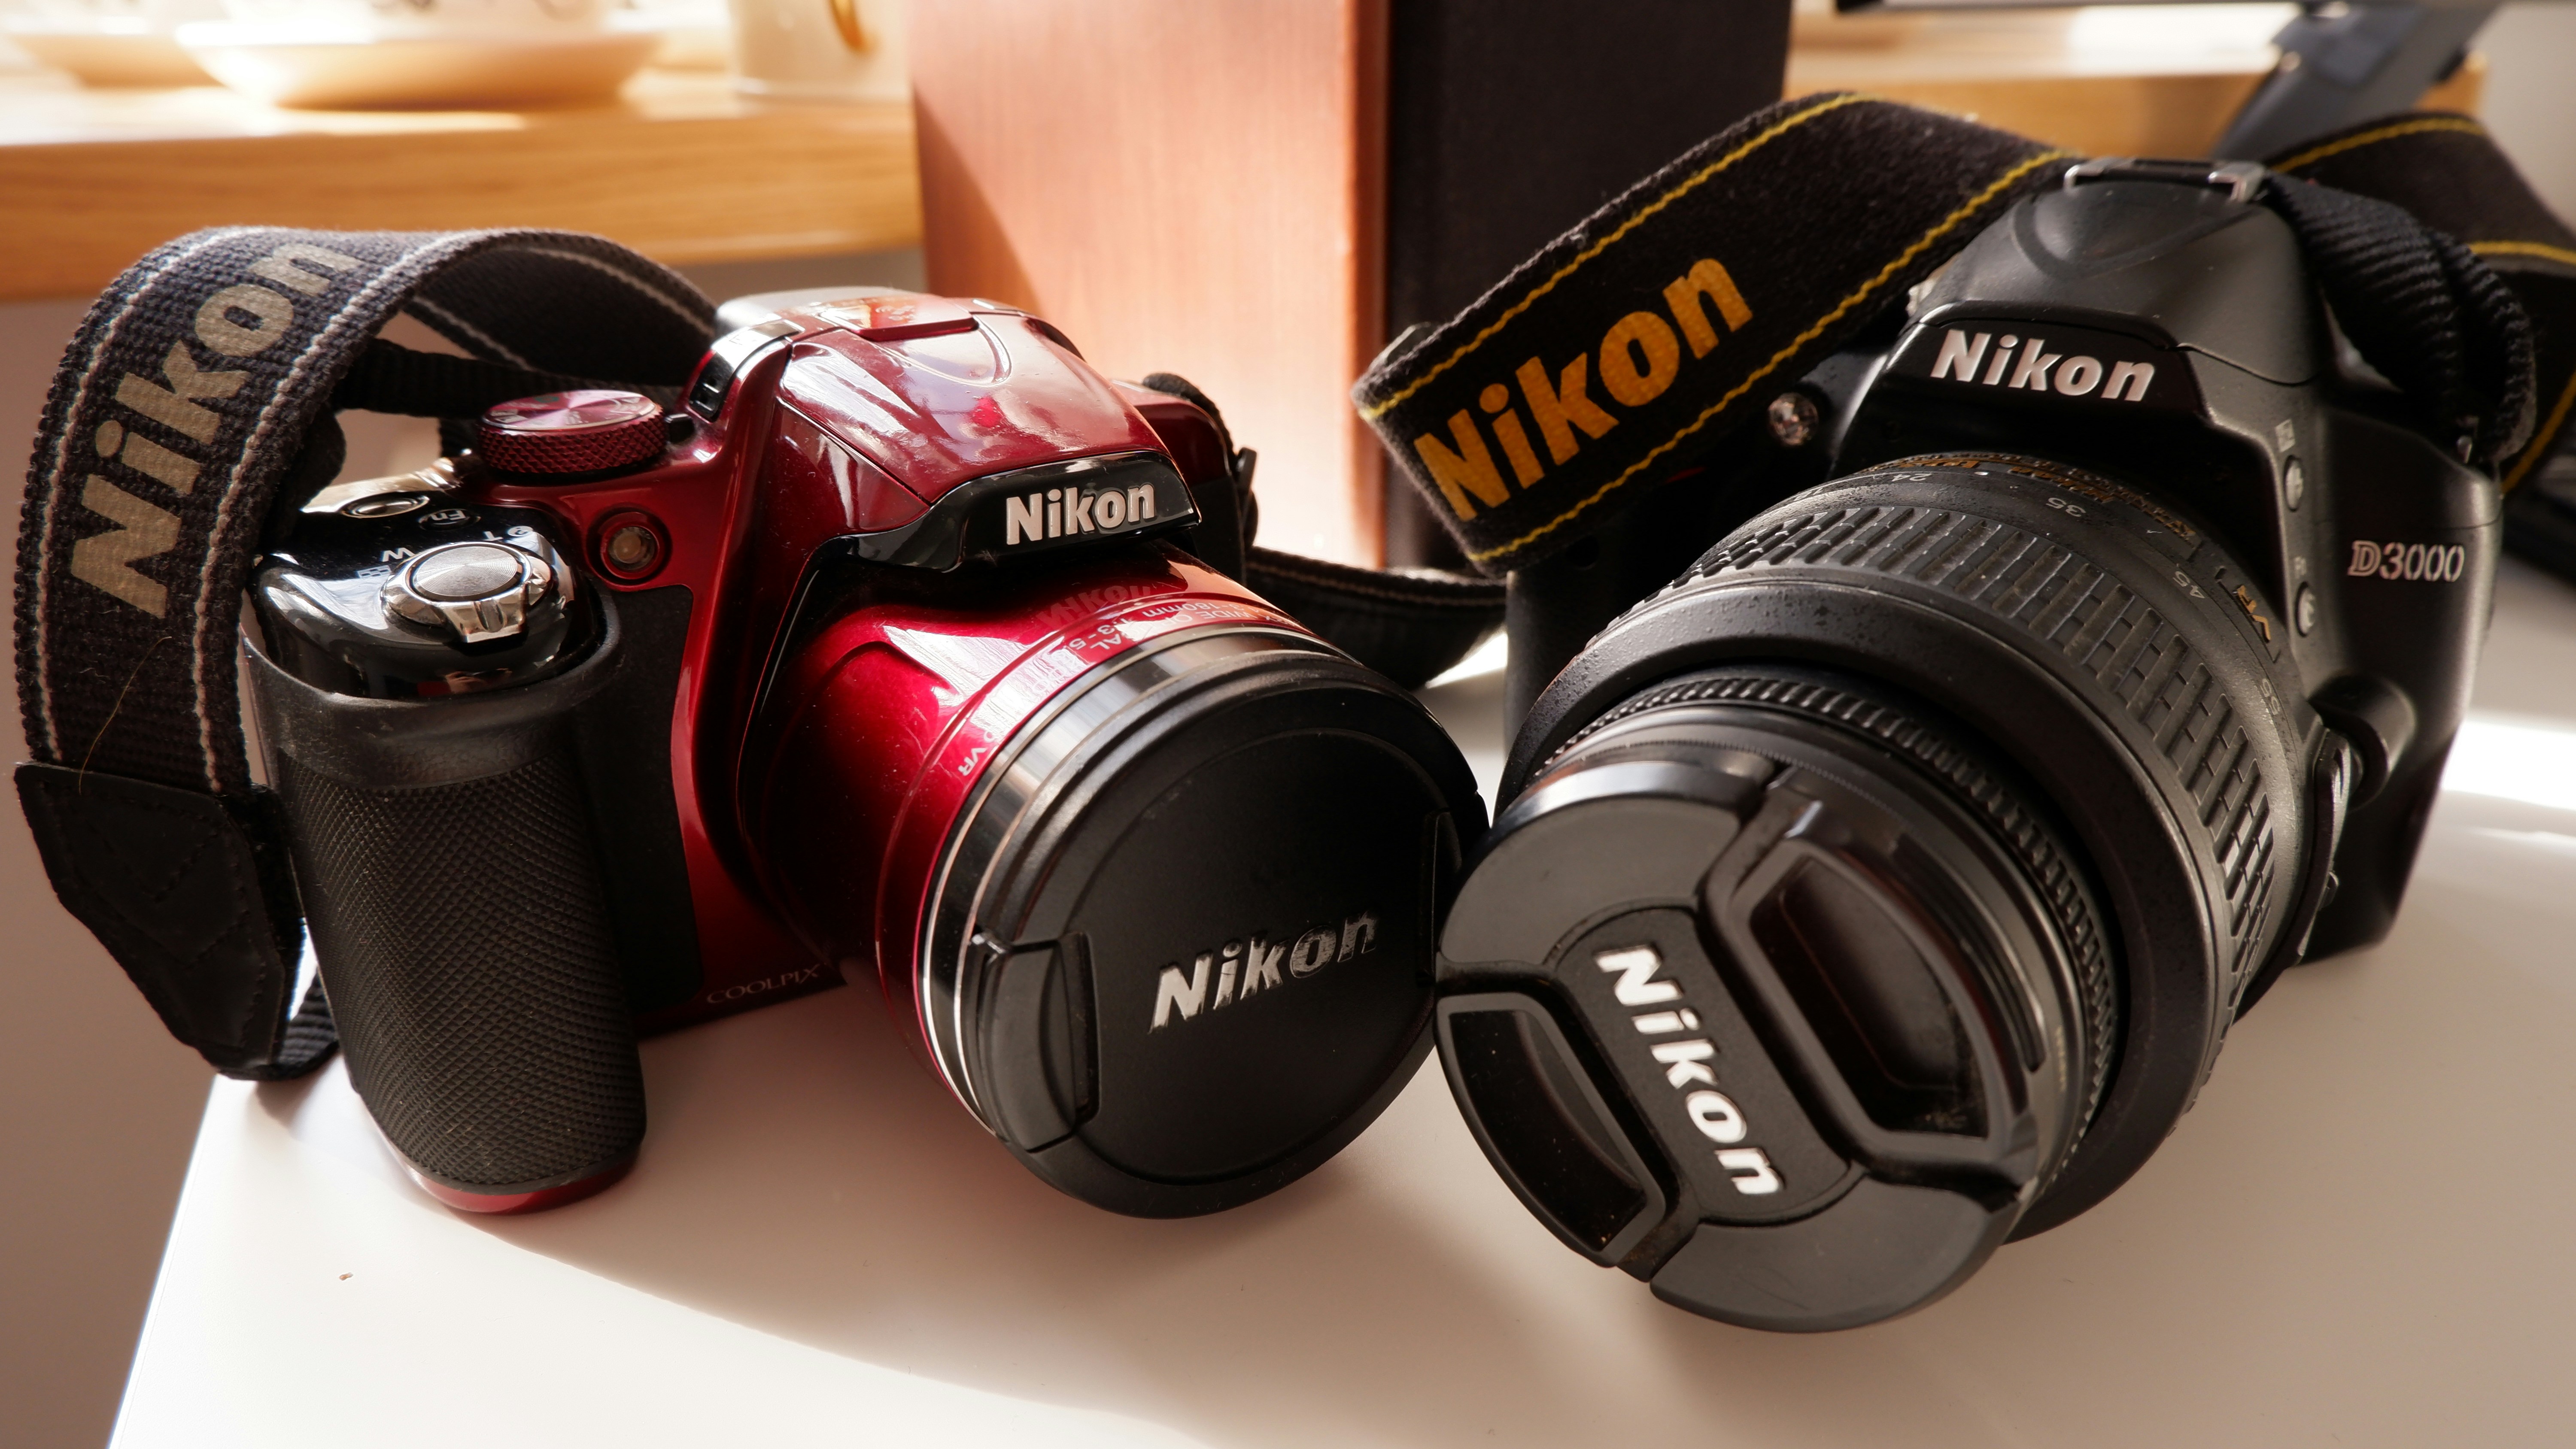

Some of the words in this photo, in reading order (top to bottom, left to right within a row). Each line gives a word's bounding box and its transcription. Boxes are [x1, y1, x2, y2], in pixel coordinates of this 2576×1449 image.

[1930, 329, 2155, 402] Nikon
[1413, 258, 1753, 522] Nikon
[70, 244, 361, 618] Nikon
[1892, 472, 1932, 482] 24
[430, 509, 466, 521] Fn
[1006, 482, 1155, 546] Nikon
[2046, 497, 2086, 517] 35
[2347, 540, 2465, 582] D3000
[2173, 571, 2205, 598] 45
[1204, 611, 1258, 619] WIDE
[958, 747, 987, 776] VR
[707, 964, 820, 1003] COOLPIX
[1148, 909, 1377, 1034] Nikon
[1593, 943, 1784, 1194] Nikon
